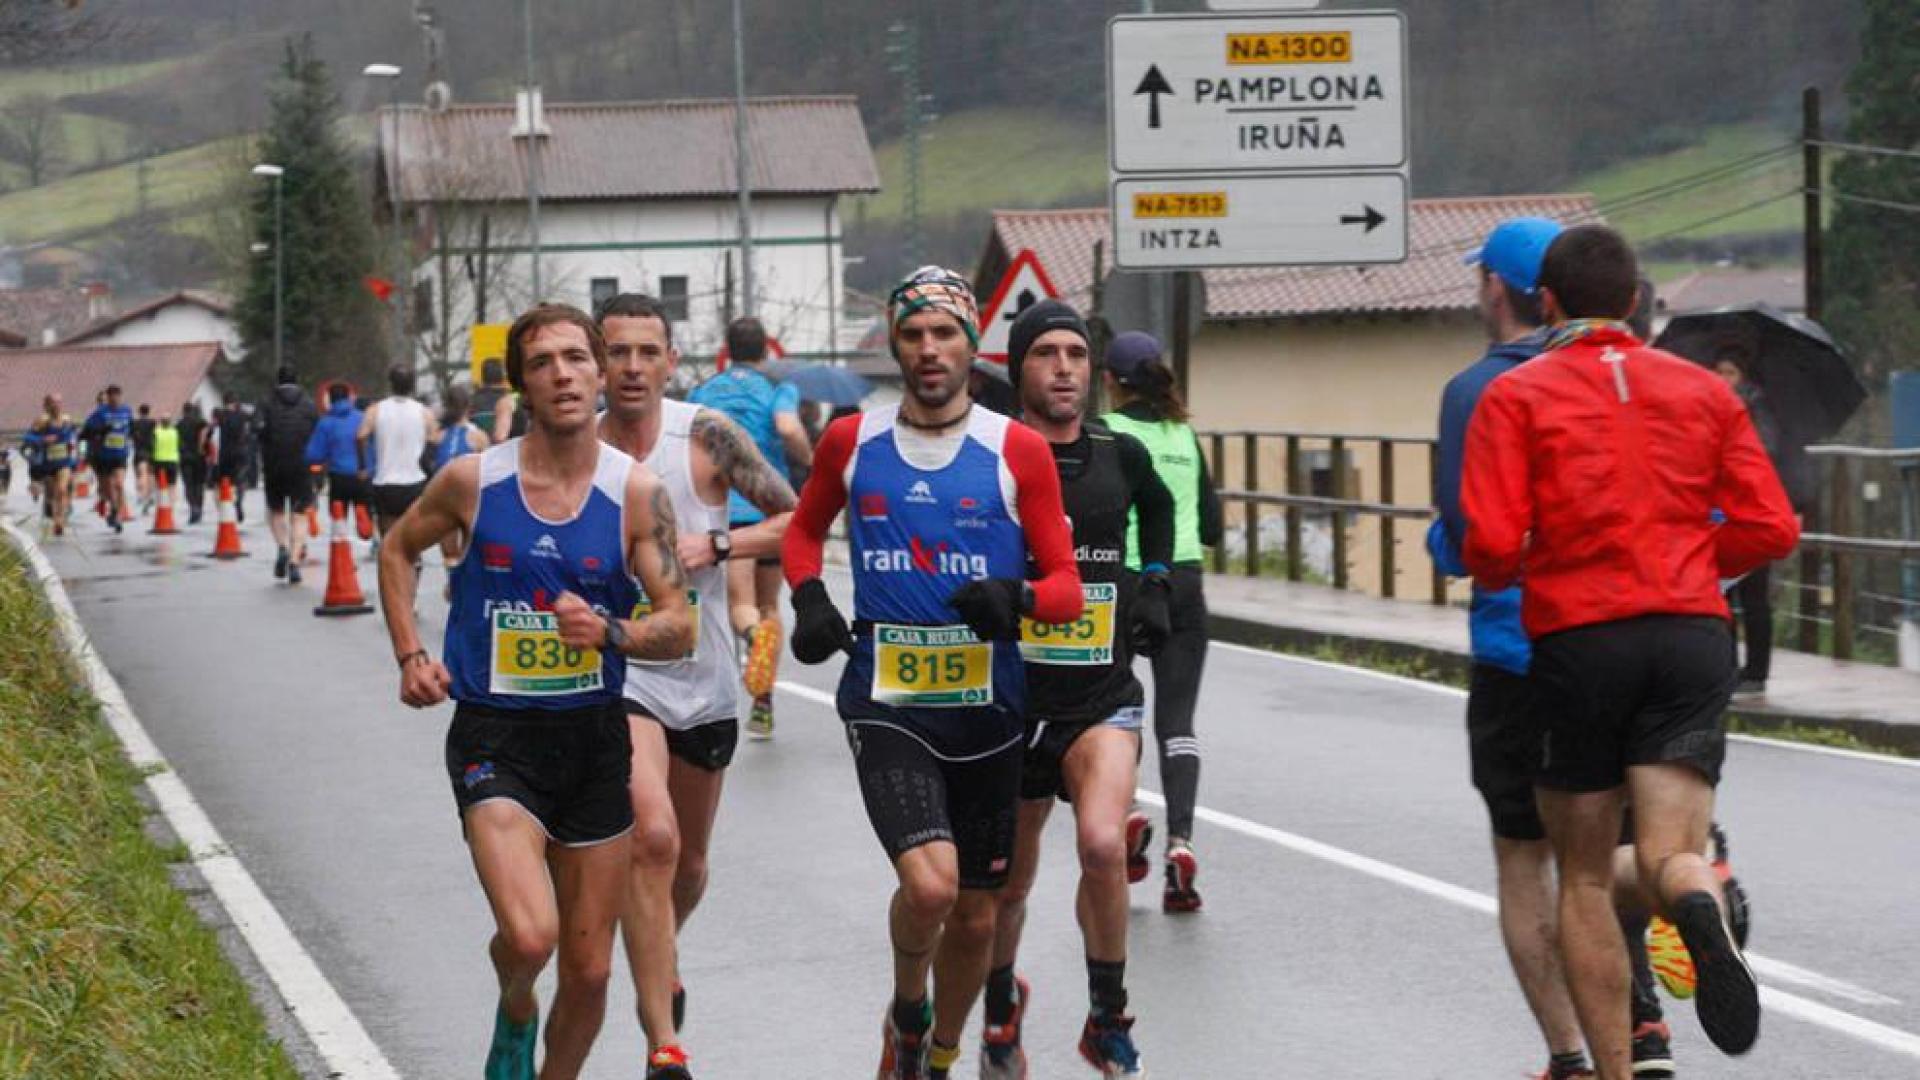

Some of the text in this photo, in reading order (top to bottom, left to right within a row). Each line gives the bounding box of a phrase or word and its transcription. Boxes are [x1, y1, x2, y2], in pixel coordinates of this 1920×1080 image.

[1230, 36, 1347, 59] NA-1300
[1194, 75, 1384, 104] PAMPLONA
[1239, 117, 1346, 150] IRUÑA
[1136, 194, 1224, 214] NA-7513
[1141, 229, 1222, 249] INTZA
[862, 536, 989, 581] ranking
[898, 652, 966, 684] 815
